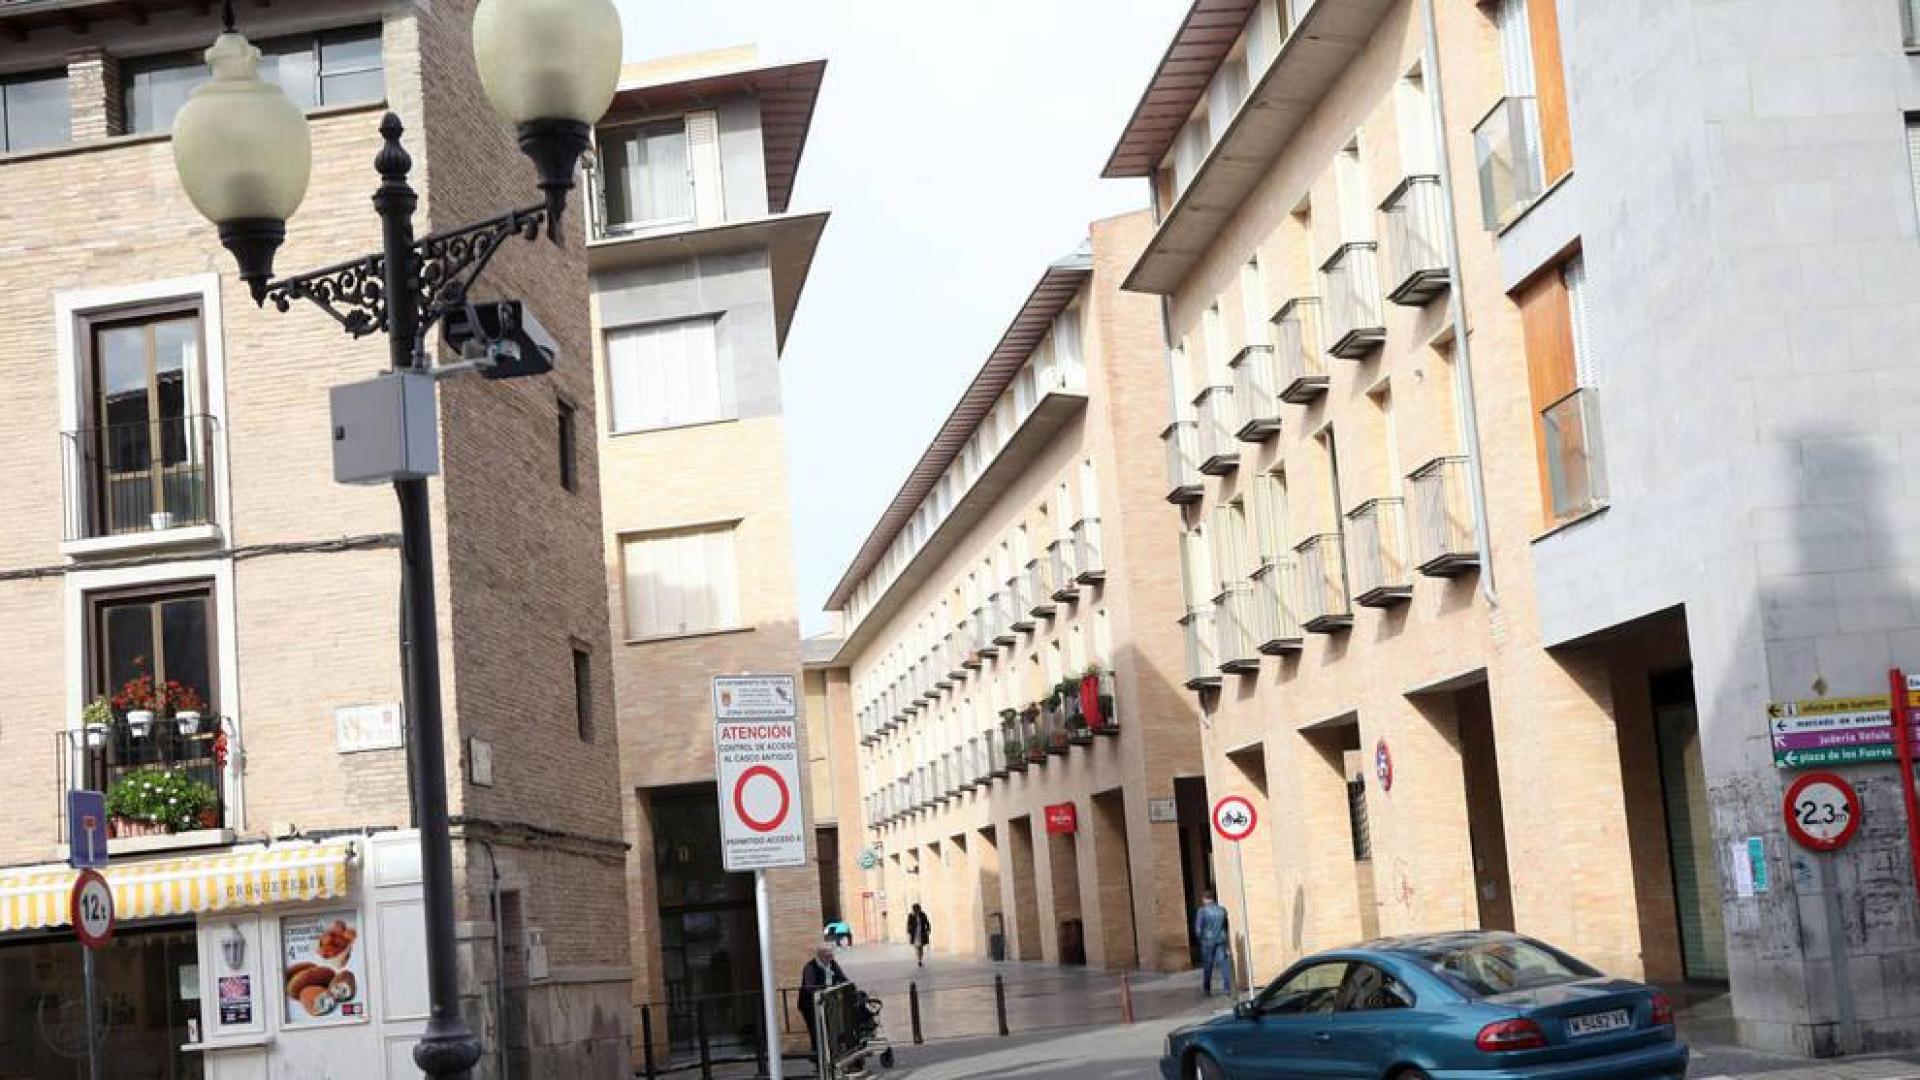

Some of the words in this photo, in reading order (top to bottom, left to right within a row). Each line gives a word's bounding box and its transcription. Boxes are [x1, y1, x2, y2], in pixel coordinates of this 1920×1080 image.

[1795, 717, 1834, 727] mercado
[720, 743, 753, 752] CONTROL
[767, 742, 797, 750] ACCESO
[1800, 752, 1826, 764] plaza
[1828, 751, 1840, 760] de
